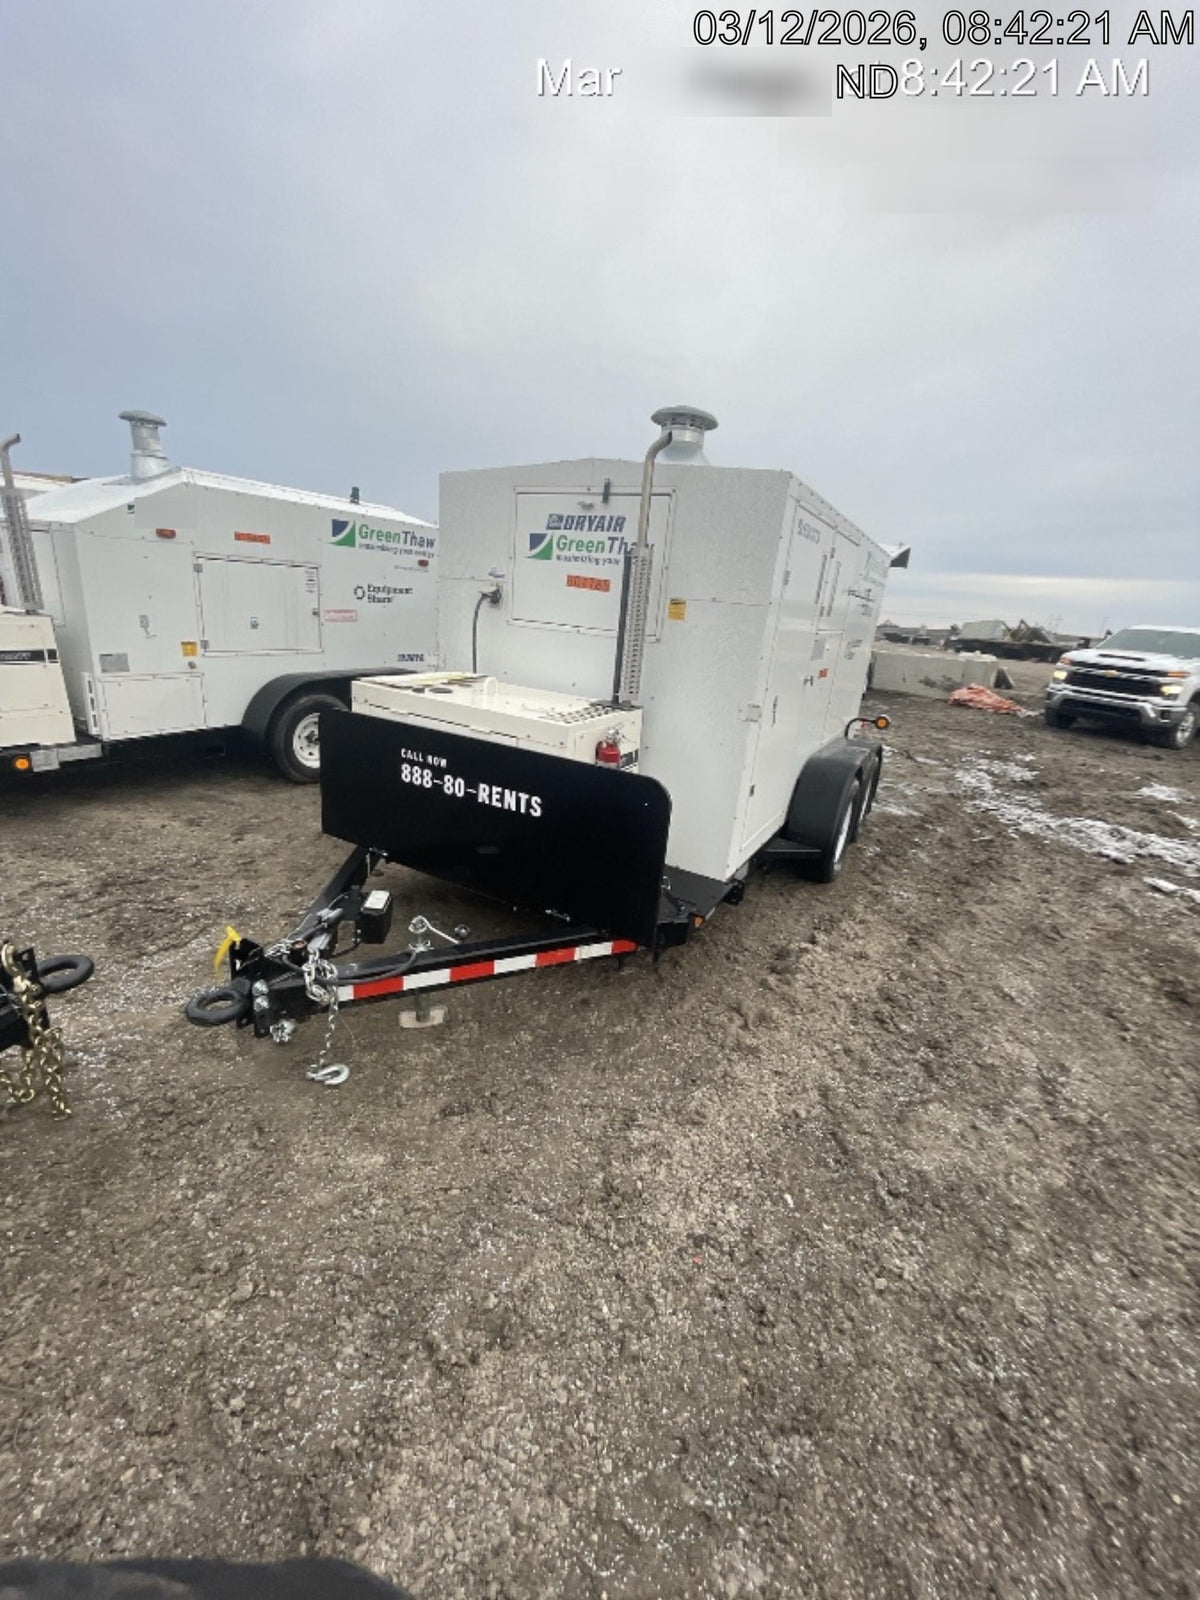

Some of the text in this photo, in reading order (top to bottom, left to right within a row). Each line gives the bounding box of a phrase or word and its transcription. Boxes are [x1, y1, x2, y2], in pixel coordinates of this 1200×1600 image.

[359, 524, 436, 548] GreenThaw
[556, 534, 654, 556] GreenTh
[401, 748, 448, 768] CALL NOW
[401, 763, 543, 817] 888-80-RENTS
